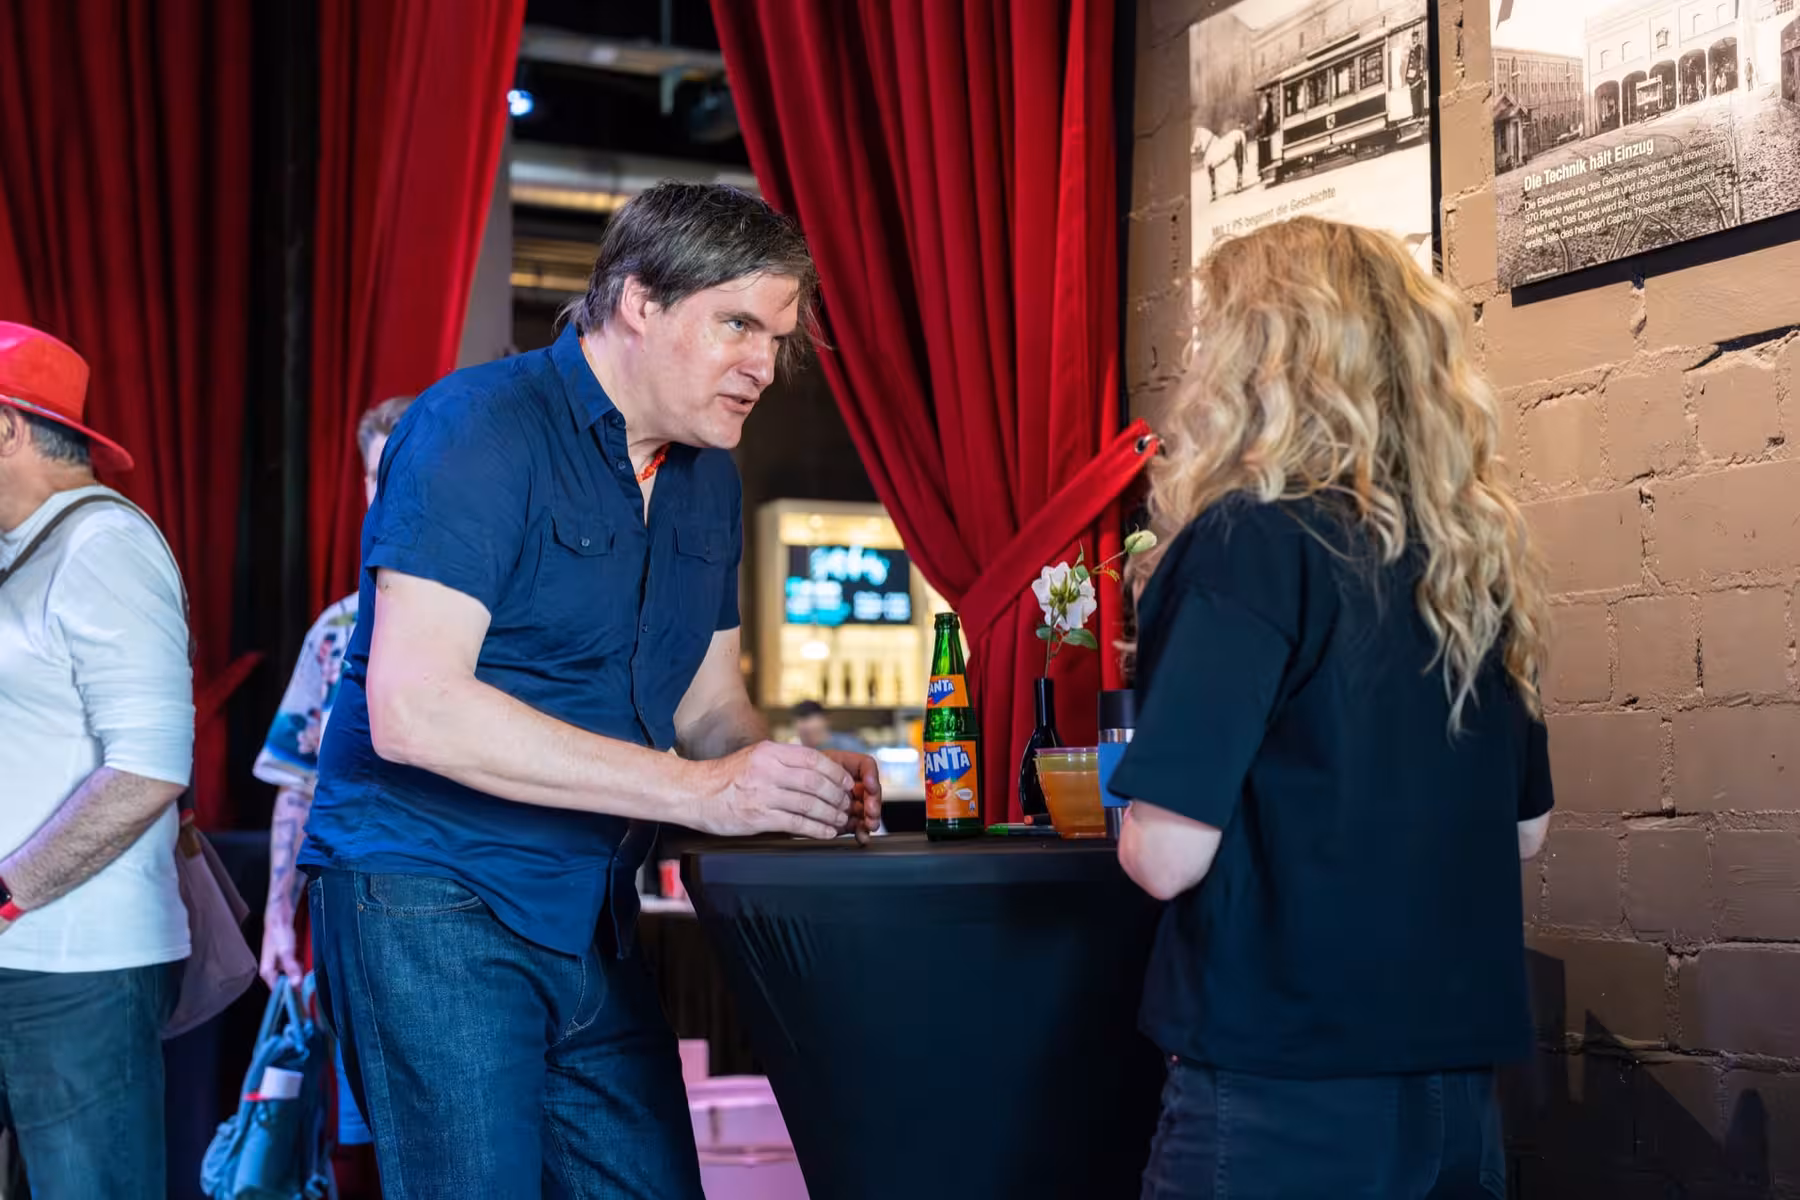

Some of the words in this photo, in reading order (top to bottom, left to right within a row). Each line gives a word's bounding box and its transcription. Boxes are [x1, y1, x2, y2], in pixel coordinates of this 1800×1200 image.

[1524, 173, 1542, 192] Die
[1543, 159, 1587, 185] Technik
[1589, 149, 1613, 171] hält
[1614, 139, 1654, 162] Einzug
[1524, 201, 1537, 212] Die
[1587, 180, 1601, 191] des
[1602, 170, 1637, 186] Geländes
[1670, 154, 1683, 165] die
[1684, 141, 1727, 161] inzwischen
[1290, 187, 1336, 211] Geschichte
[1525, 211, 1539, 224] 370
[1540, 205, 1563, 219] Pferde
[1563, 197, 1590, 212] werden
[1590, 187, 1620, 203] verkauft
[1621, 184, 1636, 195] und
[1637, 178, 1649, 188] die
[1650, 161, 1709, 186] Straßenbahnen
[1562, 214, 1577, 226] Das
[1577, 207, 1600, 221] Depot
[1601, 202, 1617, 213] wird
[1618, 198, 1629, 209] bis
[1632, 191, 1650, 204] 1903
[1652, 182, 1673, 197] stetig
[1560, 228, 1574, 239] des
[1574, 219, 1606, 235] heutigen
[1634, 201, 1667, 215] Theaters
[928, 680, 954, 696] ANTA
[925, 746, 971, 774] ANTA
